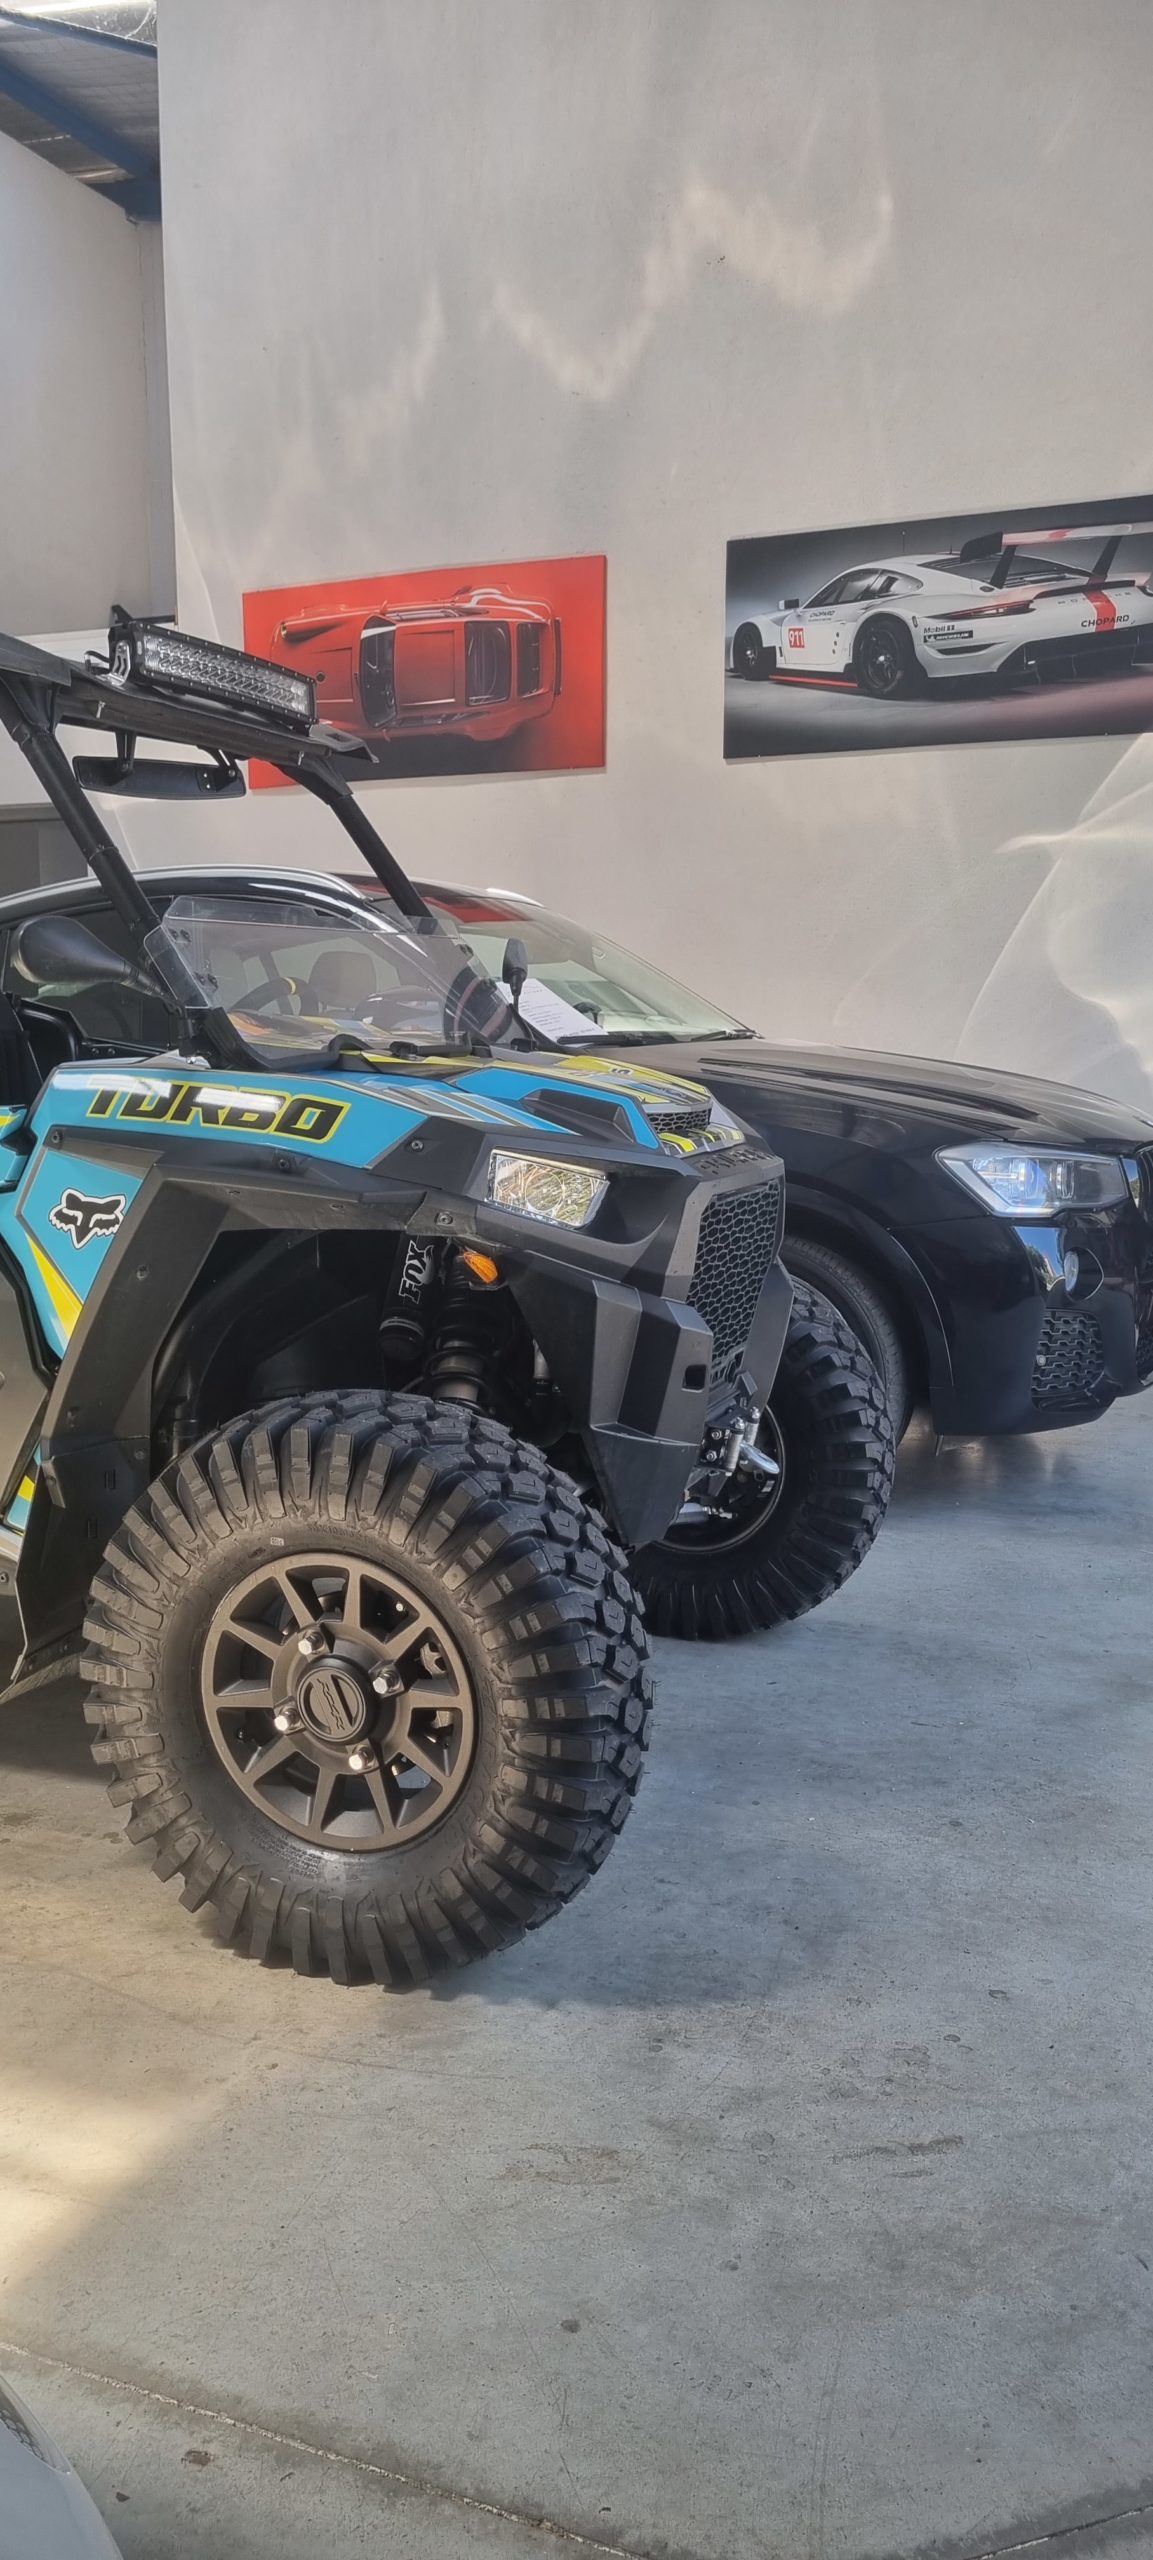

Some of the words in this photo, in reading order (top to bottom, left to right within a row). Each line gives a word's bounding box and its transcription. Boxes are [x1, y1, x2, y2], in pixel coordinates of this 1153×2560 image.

[788, 630, 805, 647] 911
[1080, 614, 1130, 628] CHOPARD
[86, 1074, 352, 1144] TURBO
[398, 1239, 434, 1305] FOX
